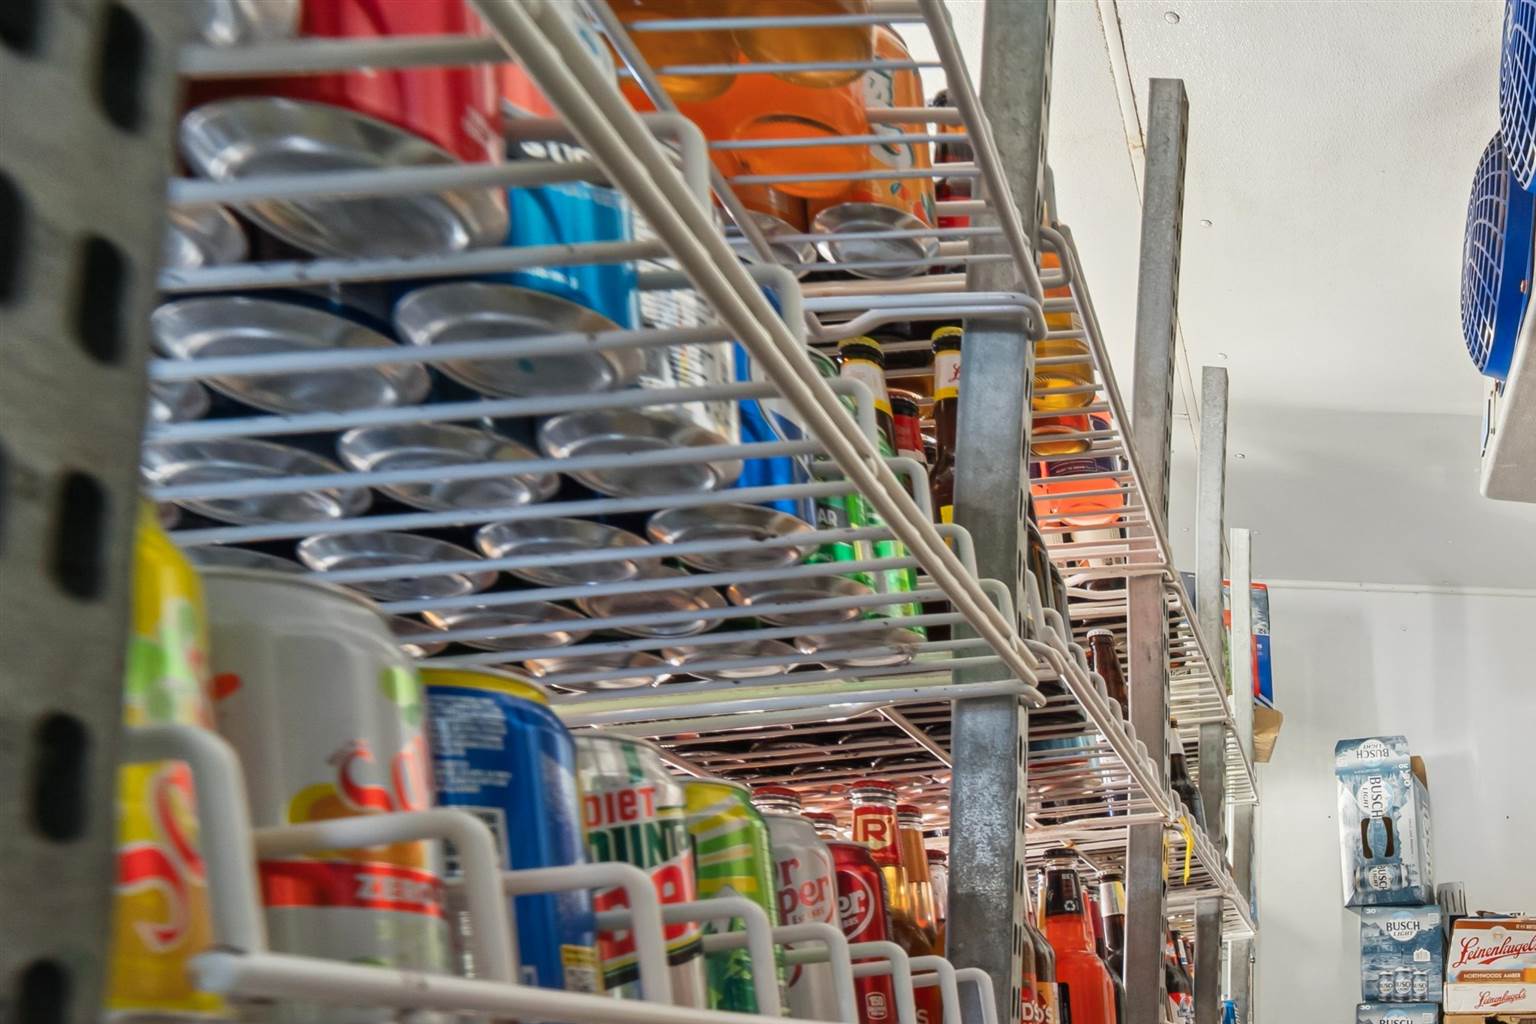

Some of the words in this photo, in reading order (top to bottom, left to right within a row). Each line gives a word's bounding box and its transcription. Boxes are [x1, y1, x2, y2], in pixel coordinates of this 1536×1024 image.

[1356, 748, 1391, 759] BUSCH
[1369, 776, 1384, 819] BUSCH
[1386, 920, 1421, 932] BUSCH
[1474, 988, 1527, 1010] Leinenkugel's
